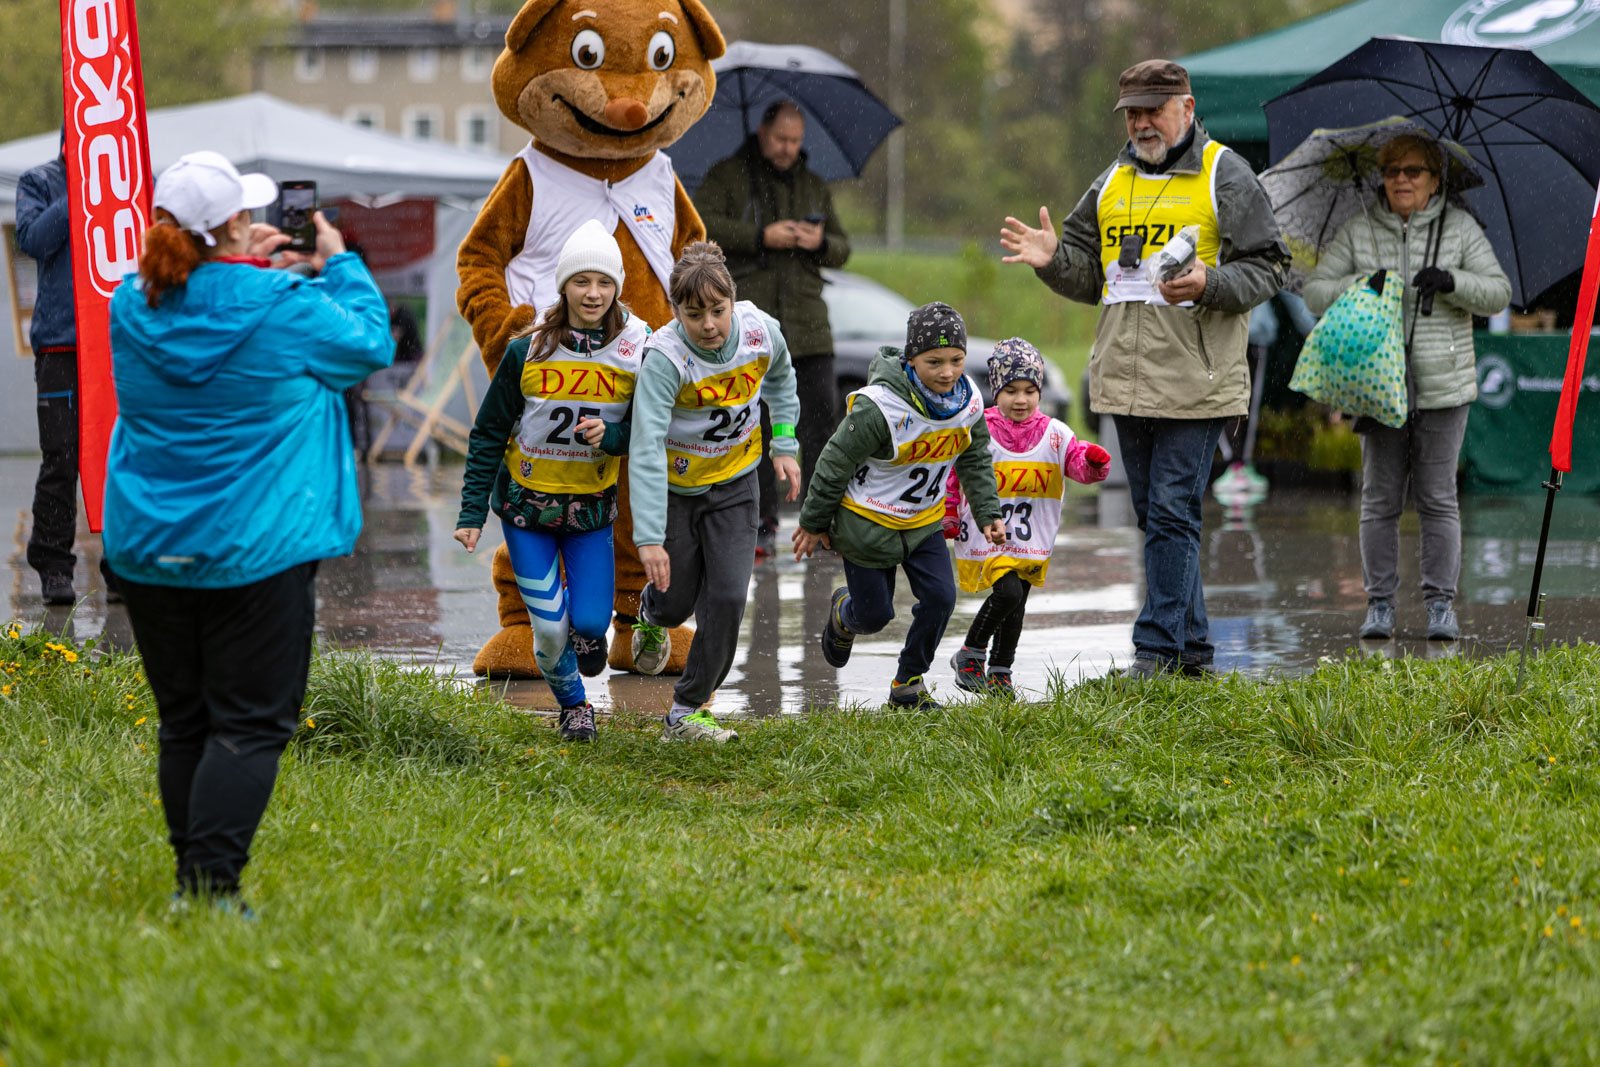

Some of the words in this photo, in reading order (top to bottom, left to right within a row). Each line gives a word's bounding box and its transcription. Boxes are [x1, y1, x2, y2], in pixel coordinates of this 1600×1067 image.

[538, 368, 619, 399] DZN
[694, 367, 761, 407] DZN
[545, 406, 601, 447] 25
[702, 404, 751, 443] 22
[556, 448, 590, 459] Związek
[667, 438, 712, 454] Dolnośląski
[908, 433, 969, 462] DZN
[851, 462, 870, 487] 4
[899, 465, 947, 505] 24
[1000, 501, 1033, 541] 23
